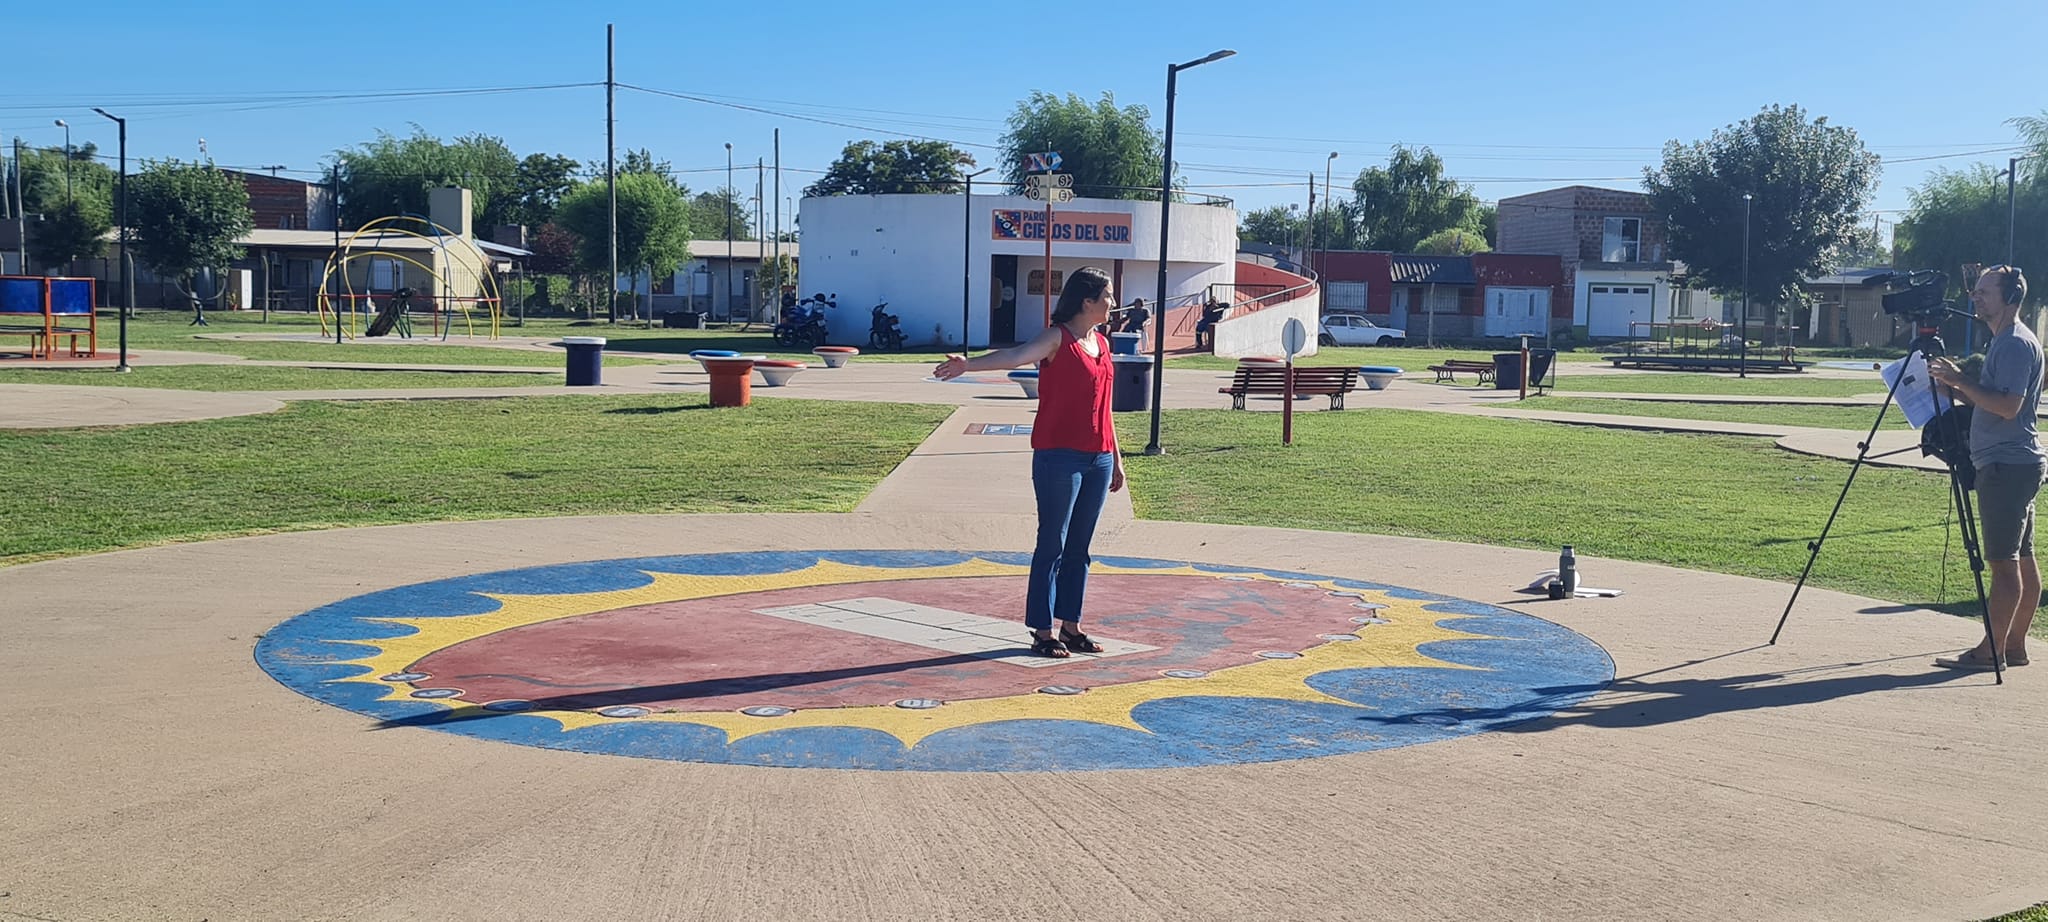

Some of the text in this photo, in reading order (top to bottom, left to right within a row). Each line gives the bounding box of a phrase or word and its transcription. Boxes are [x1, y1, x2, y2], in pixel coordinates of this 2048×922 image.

[1023, 222, 1129, 241] CIEOS DEL SUR
